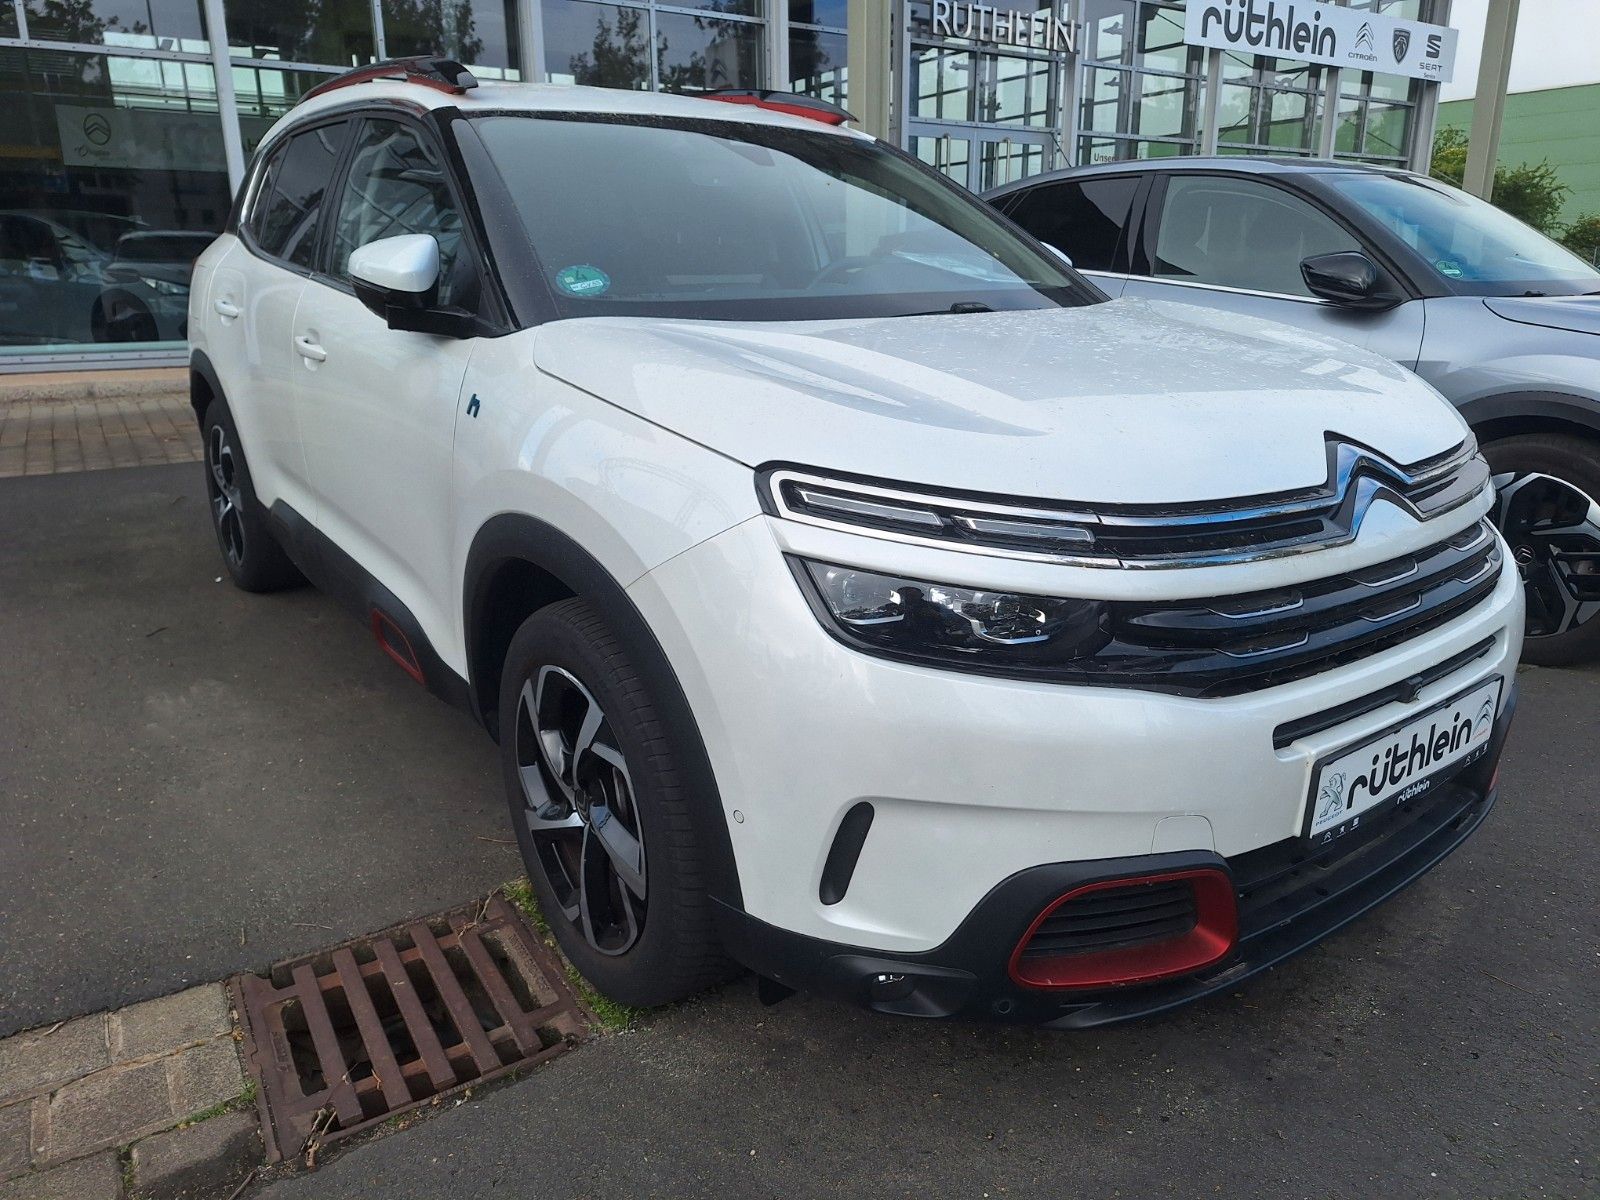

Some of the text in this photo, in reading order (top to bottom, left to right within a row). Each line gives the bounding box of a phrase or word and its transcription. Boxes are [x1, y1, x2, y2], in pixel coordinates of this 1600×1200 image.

[1201, 0, 1337, 58] rüthlein
[1347, 51, 1378, 63] CITROËN
[1419, 62, 1443, 73] SEAT
[1346, 711, 1473, 810] rüthlein
[1396, 779, 1431, 805] rüthlein
